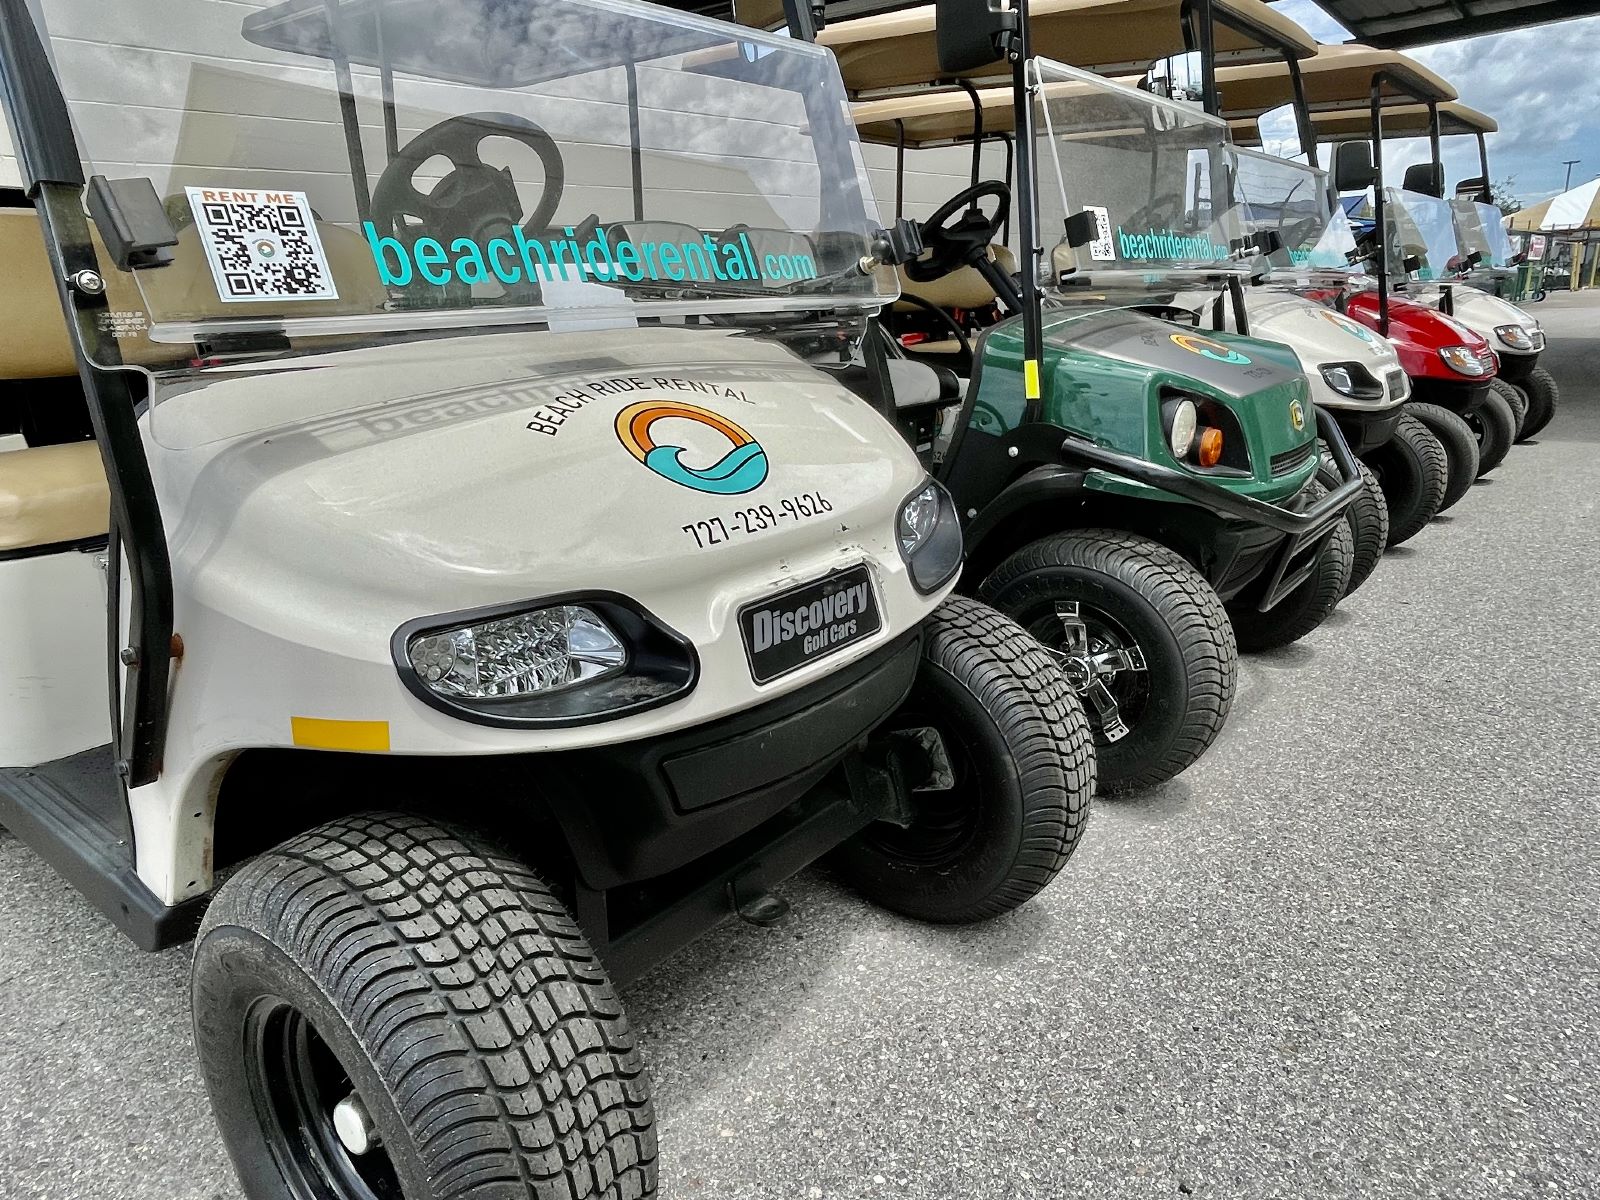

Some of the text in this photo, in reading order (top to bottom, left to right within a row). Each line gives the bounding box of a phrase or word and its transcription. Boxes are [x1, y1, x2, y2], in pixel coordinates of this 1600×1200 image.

[202, 190, 296, 205] RENT ME
[362, 220, 817, 287] beachriderental.com
[526, 388, 596, 437] BEACH
[586, 376, 652, 398] RIDE
[652, 377, 757, 405] RENTAL
[681, 491, 834, 549] 727-239-9626
[752, 581, 868, 654] Discovery
[803, 619, 857, 655] Golf Cars
